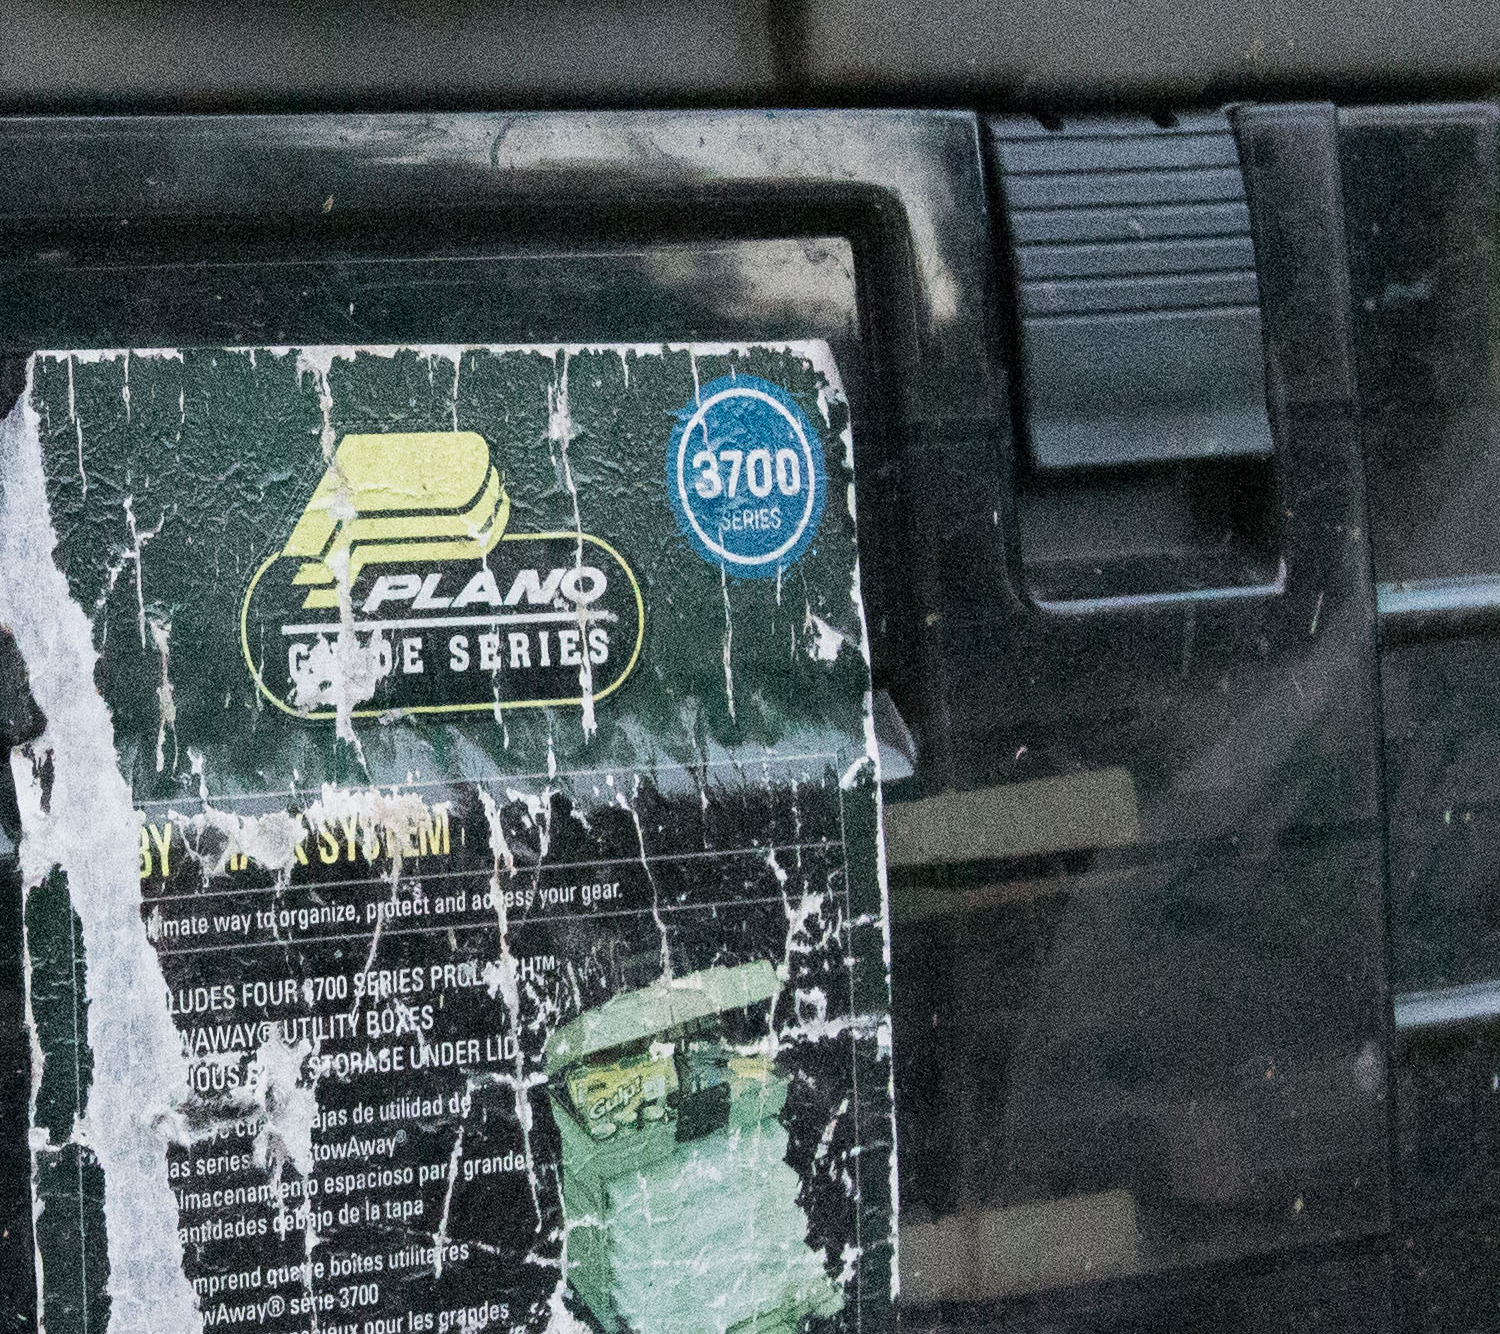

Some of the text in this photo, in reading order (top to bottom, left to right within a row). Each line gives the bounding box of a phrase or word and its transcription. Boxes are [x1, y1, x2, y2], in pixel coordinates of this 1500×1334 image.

[692, 448, 801, 499] 3700
[719, 506, 782, 532] SERIES
[361, 566, 608, 613] PLANO
[288, 629, 610, 676] GDE SERIES
[319, 803, 452, 866] SYEM
[213, 914, 252, 936] way
[256, 911, 275, 930] to
[279, 901, 361, 931] organize,
[365, 892, 431, 924] protect
[434, 888, 467, 915] and
[538, 884, 577, 911] your
[580, 880, 624, 907] gear.
[242, 979, 299, 1009] FOUR
[353, 967, 424, 998] SERIES
[283, 1012, 360, 1045] UTILITY
[366, 1004, 434, 1036] BOXES
[308, 1044, 403, 1080] STORAGE
[409, 1039, 480, 1069] UNDER
[485, 1034, 520, 1062] LID
[352, 1101, 374, 1124] de
[378, 1094, 443, 1122] utilidad
[448, 1094, 472, 1116] de
[195, 1150, 251, 1175] series
[308, 1129, 407, 1164] towAway®
[323, 1169, 414, 1199] espacioso
[418, 1161, 457, 1188] par
[463, 1150, 532, 1183] grande
[272, 1207, 333, 1235] debajo
[337, 1199, 360, 1225] de
[364, 1198, 383, 1222] la
[385, 1198, 425, 1230] tapa
[266, 1261, 325, 1289] quae
[330, 1250, 383, 1280] boîtes
[387, 1241, 470, 1272] utilitares
[289, 1289, 335, 1316] série
[338, 1282, 380, 1310] 3700
[407, 1308, 434, 1333] les
[438, 1299, 510, 1334] grandes
